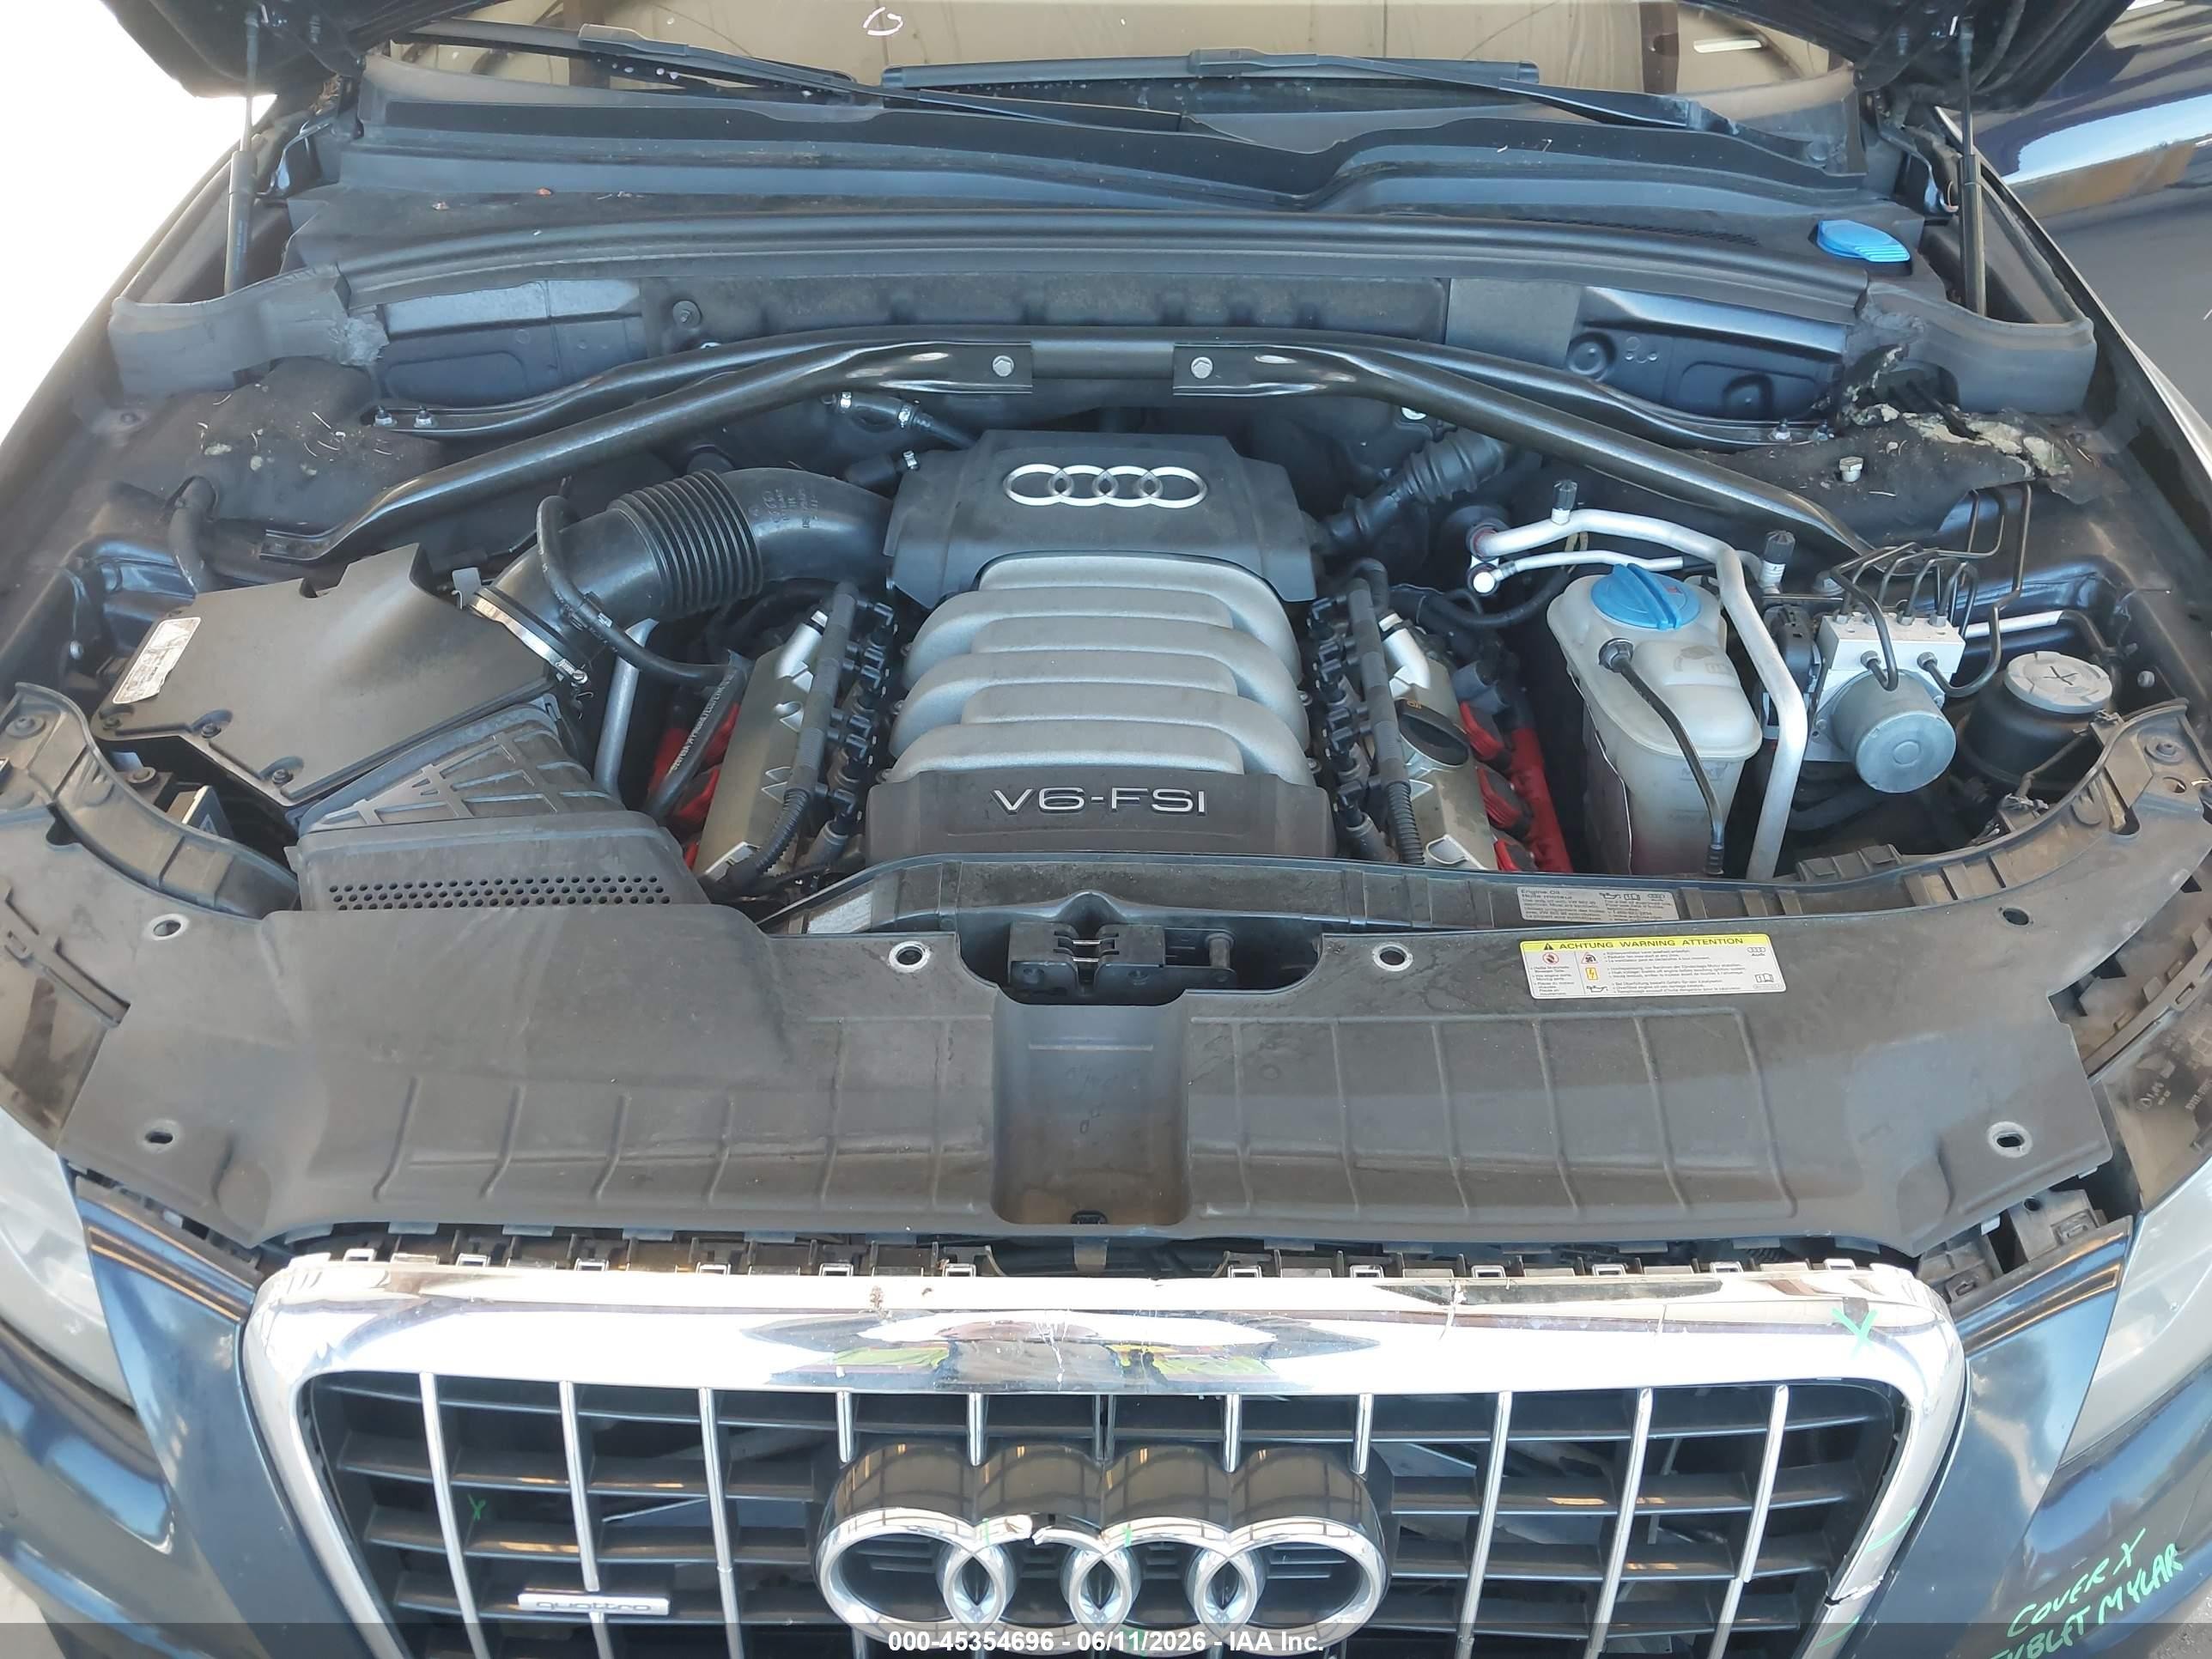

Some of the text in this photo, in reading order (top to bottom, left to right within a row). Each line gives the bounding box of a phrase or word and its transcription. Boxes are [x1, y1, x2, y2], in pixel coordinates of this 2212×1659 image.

[993, 786, 1206, 814] V6-FSI
[1559, 937, 1744, 950] ACHTUNG WARNING ATTENTION
[2006, 1558, 2110, 1638] COVER
[2098, 1542, 2184, 1626] MYLAR
[536, 1601, 651, 1611] quattro
